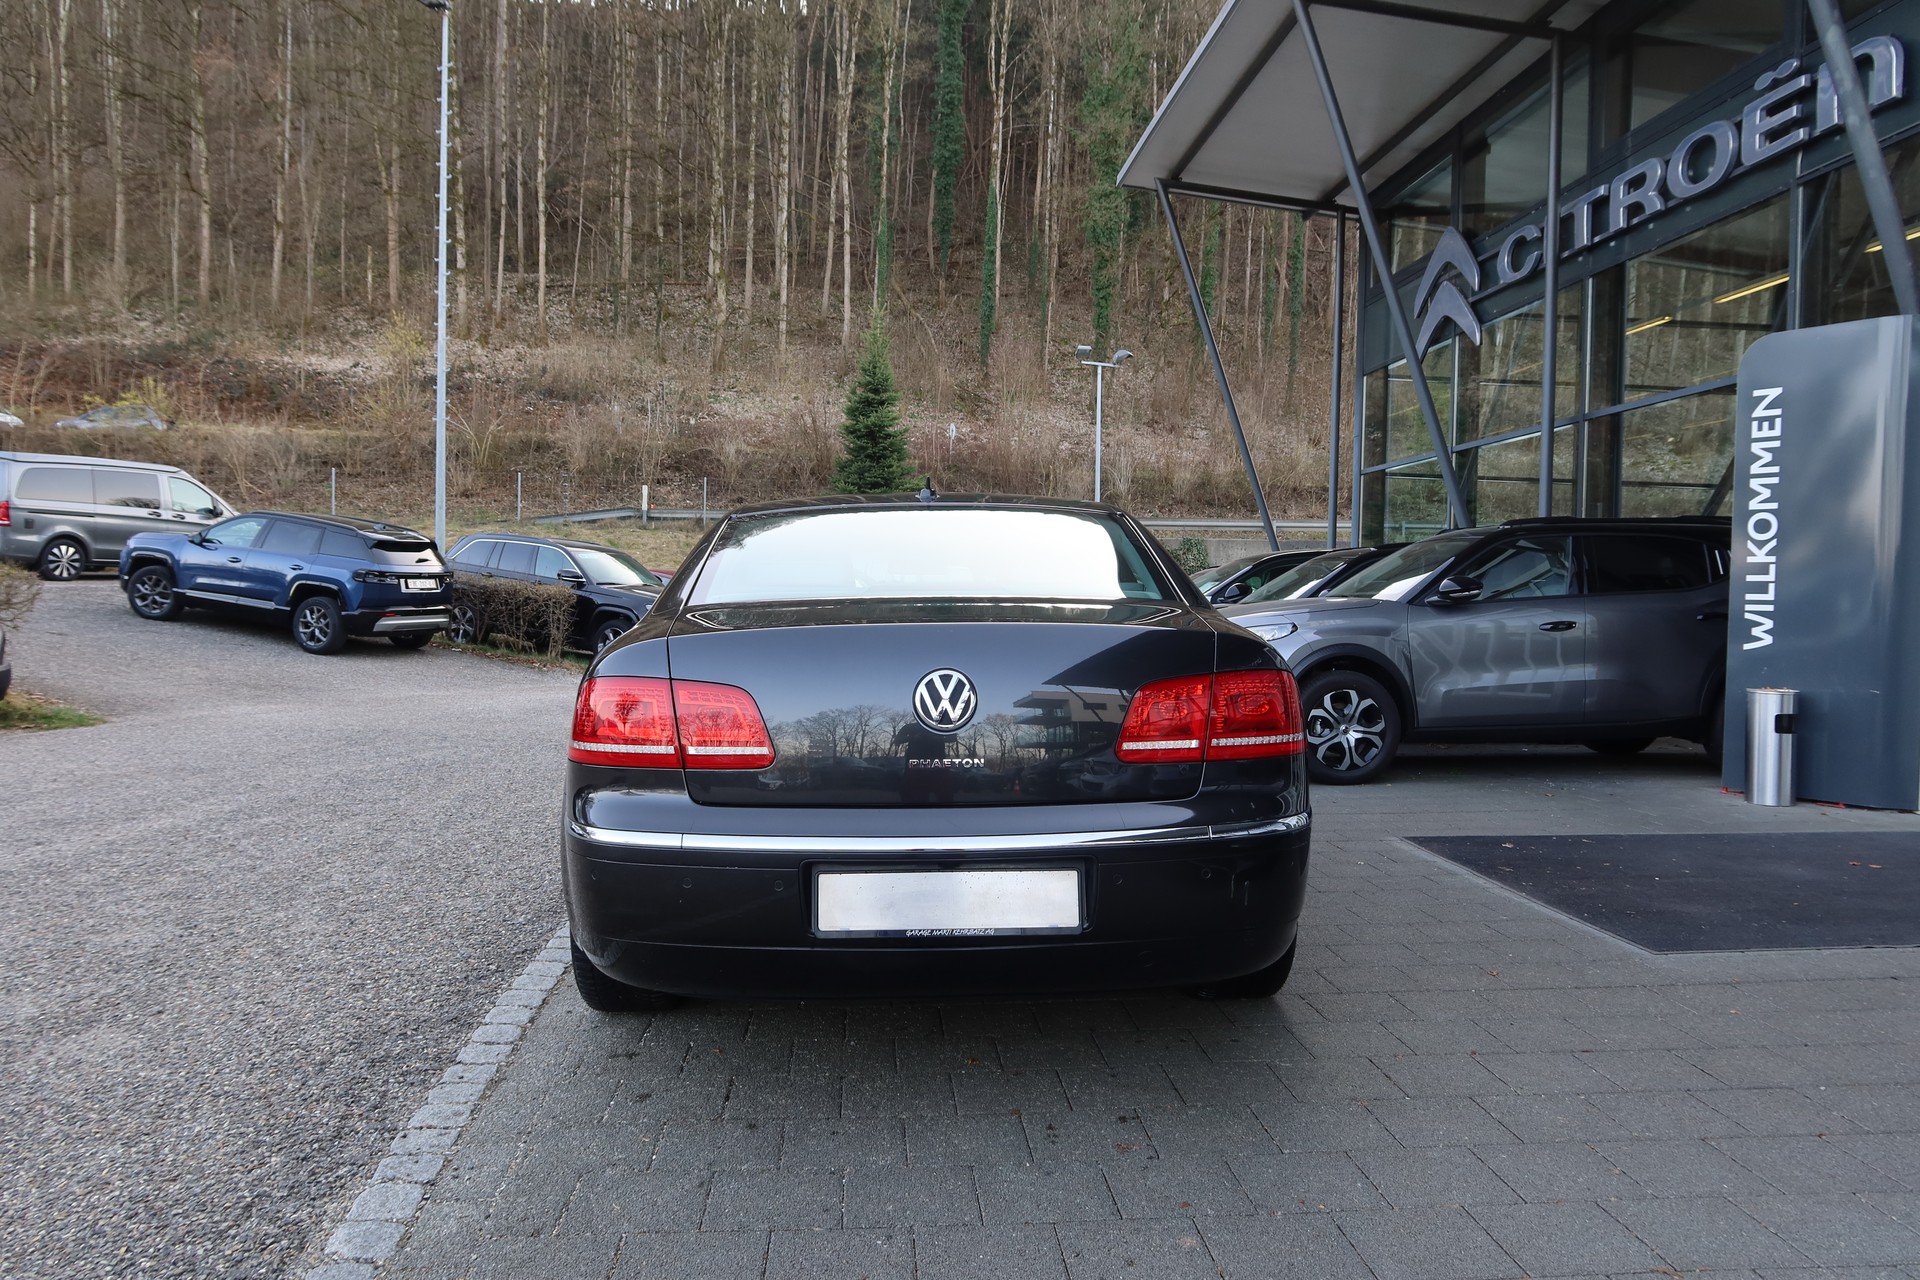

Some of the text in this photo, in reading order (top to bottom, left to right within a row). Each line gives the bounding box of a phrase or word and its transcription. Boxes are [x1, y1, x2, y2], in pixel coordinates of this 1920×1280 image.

[1743, 386, 1784, 650] WILLKOMMEN
[915, 670, 975, 729] VW
[908, 758, 985, 769] PHAETON
[905, 929, 931, 937] GARAGE
[985, 928, 995, 936] AG
